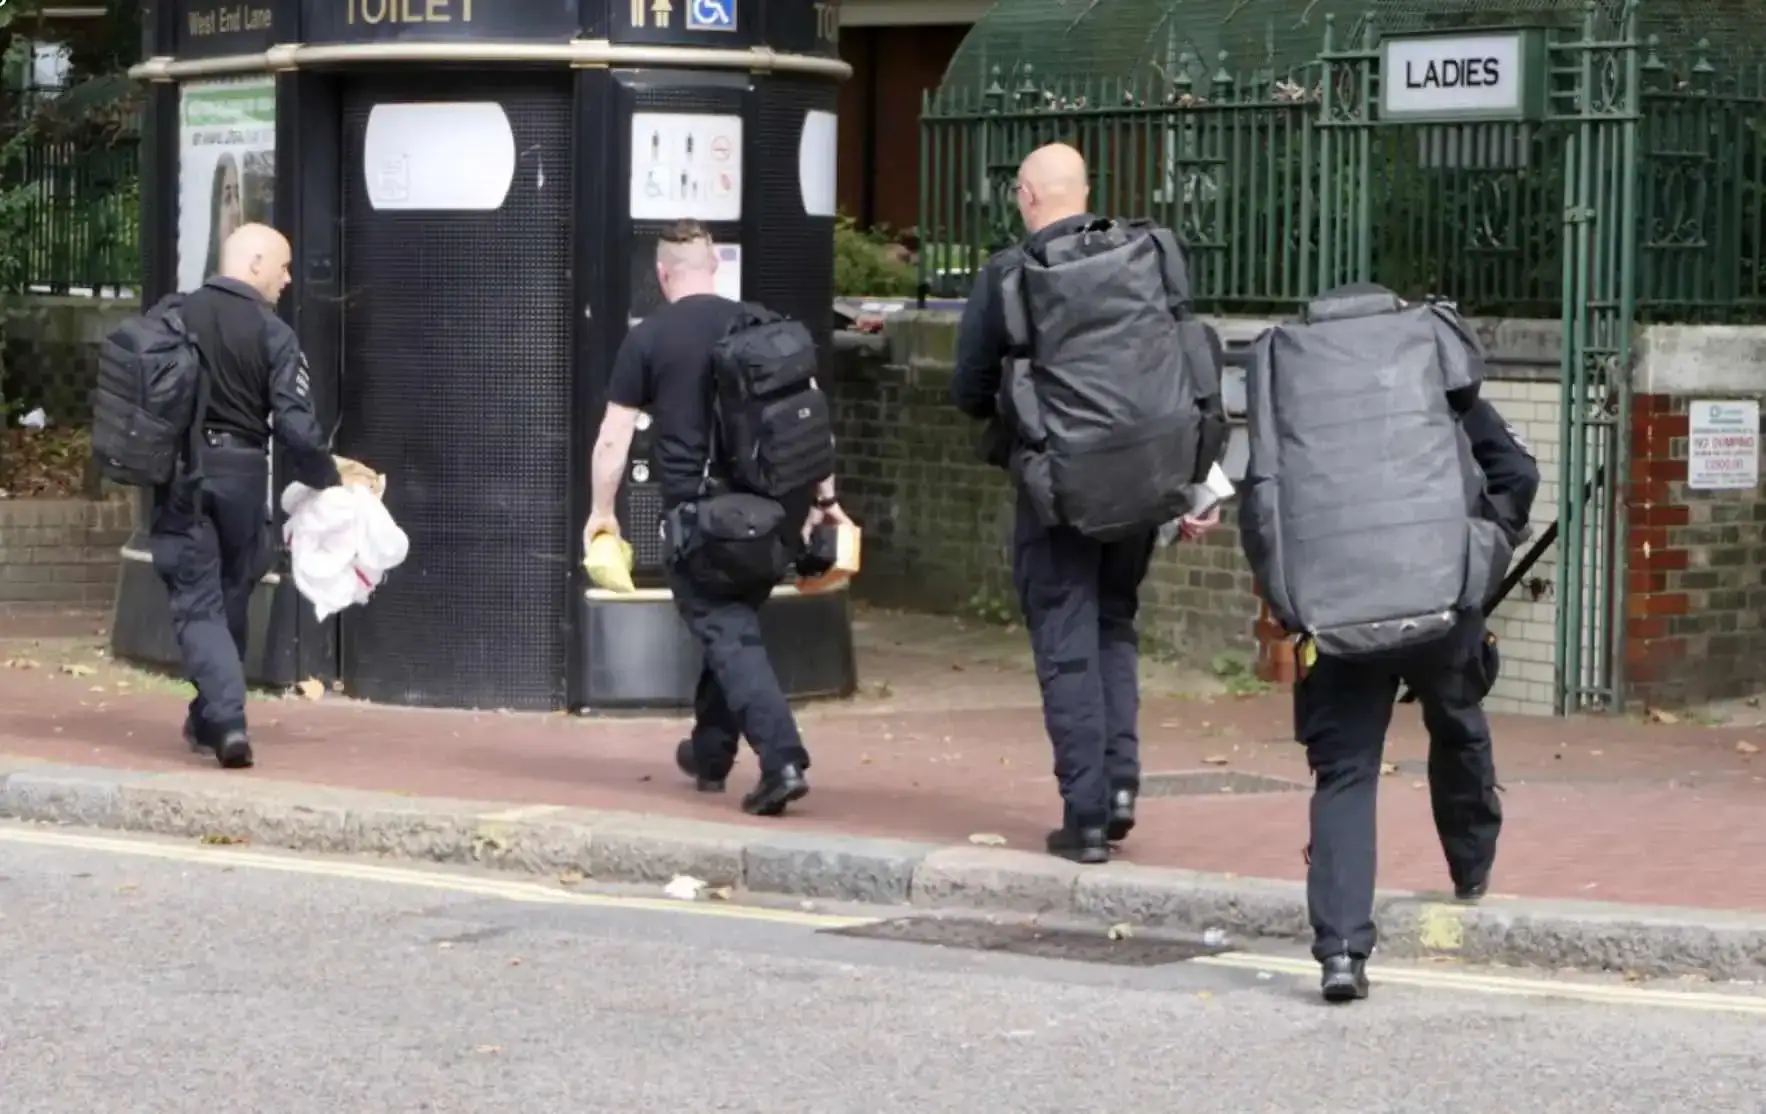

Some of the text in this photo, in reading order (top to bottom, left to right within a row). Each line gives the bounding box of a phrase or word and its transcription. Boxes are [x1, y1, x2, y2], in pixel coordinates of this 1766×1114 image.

[187, 4, 272, 36] West End Lane
[1405, 57, 1500, 89] LADIES
